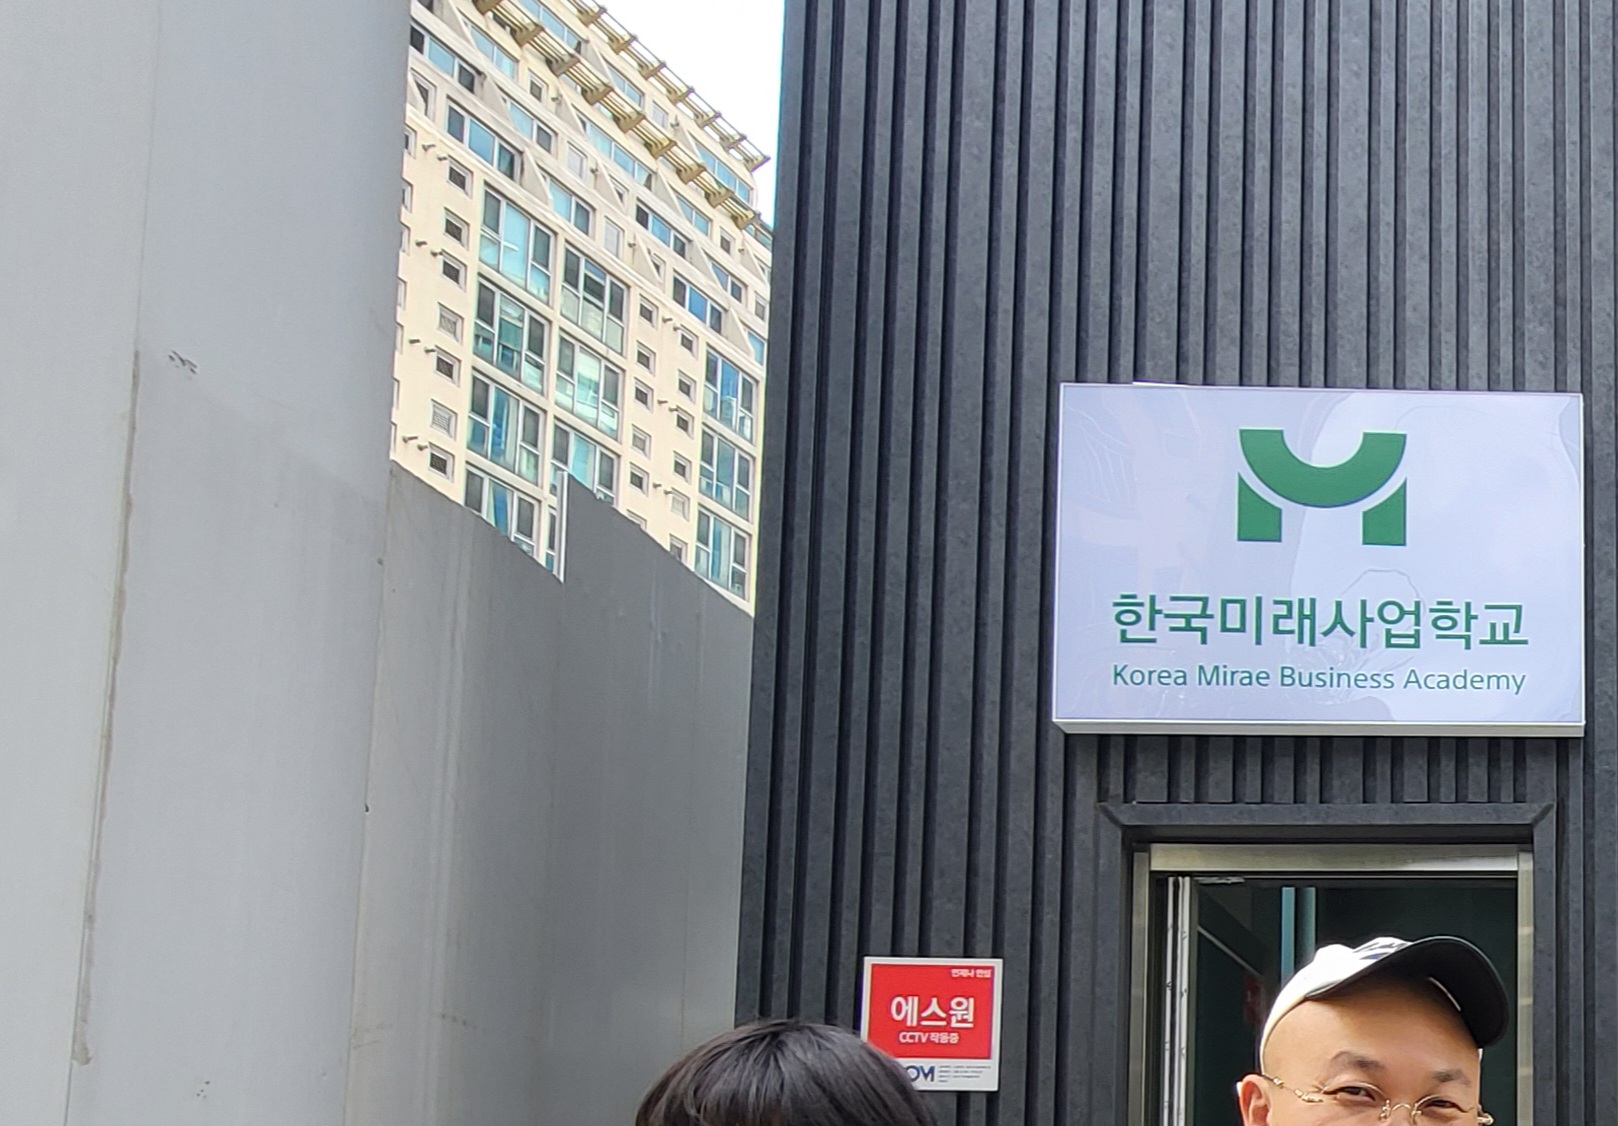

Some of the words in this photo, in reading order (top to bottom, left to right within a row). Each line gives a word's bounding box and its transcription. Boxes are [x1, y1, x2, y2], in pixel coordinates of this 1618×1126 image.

[1112, 592, 1529, 650] 한국미래사업학교
[1112, 664, 1188, 687] Korea
[1197, 665, 1270, 688] Mirae
[1280, 666, 1395, 690] Business
[1403, 668, 1526, 695] Academy
[890, 996, 975, 1028] 에스원
[899, 1032, 928, 1043] CCTV
